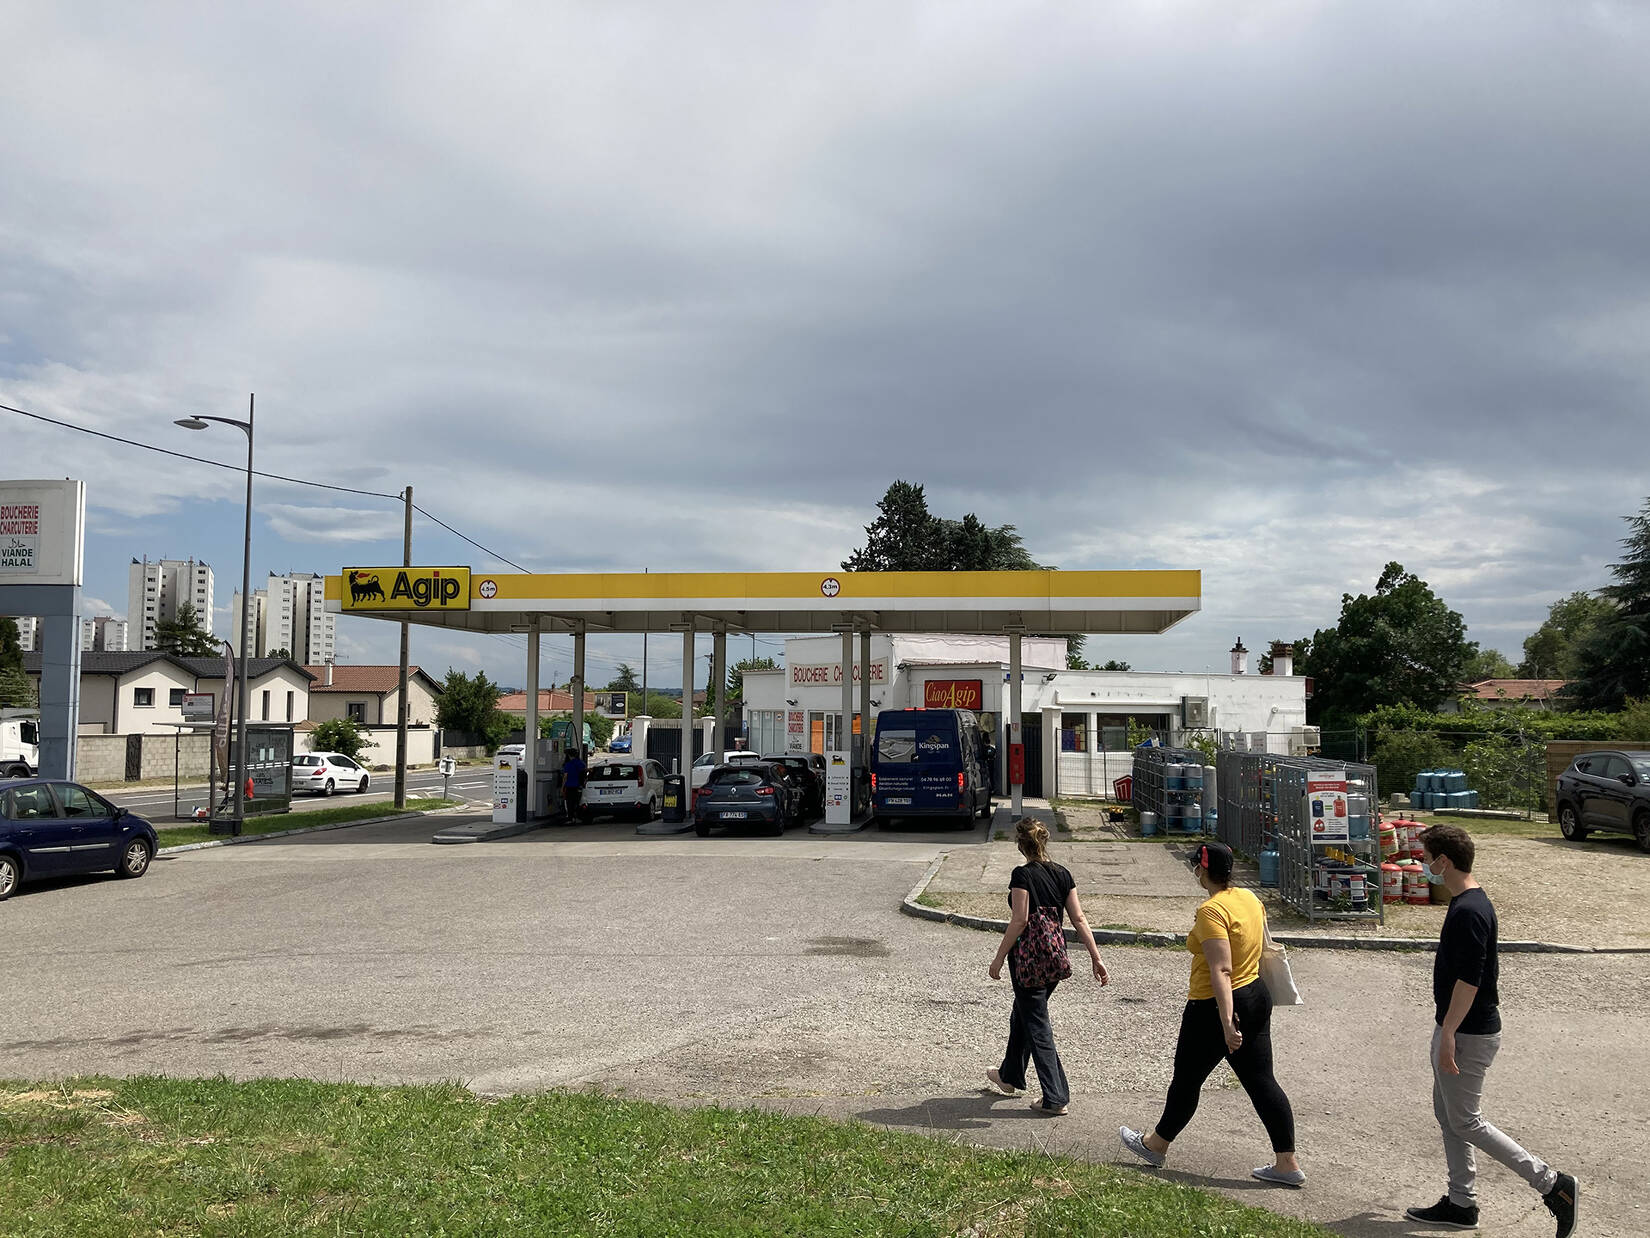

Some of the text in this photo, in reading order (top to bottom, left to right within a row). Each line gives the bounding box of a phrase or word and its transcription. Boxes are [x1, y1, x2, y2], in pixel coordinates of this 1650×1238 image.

[1, 505, 39, 520] BOUCHERIE
[0, 521, 38, 535] CHARCUTERIE
[2, 548, 33, 557] VIANDE
[1, 558, 32, 567] HALAL
[391, 571, 460, 607] Agip
[793, 664, 883, 682] BOUCHERIE CHCUERIE
[918, 742, 949, 751] Kingspan
